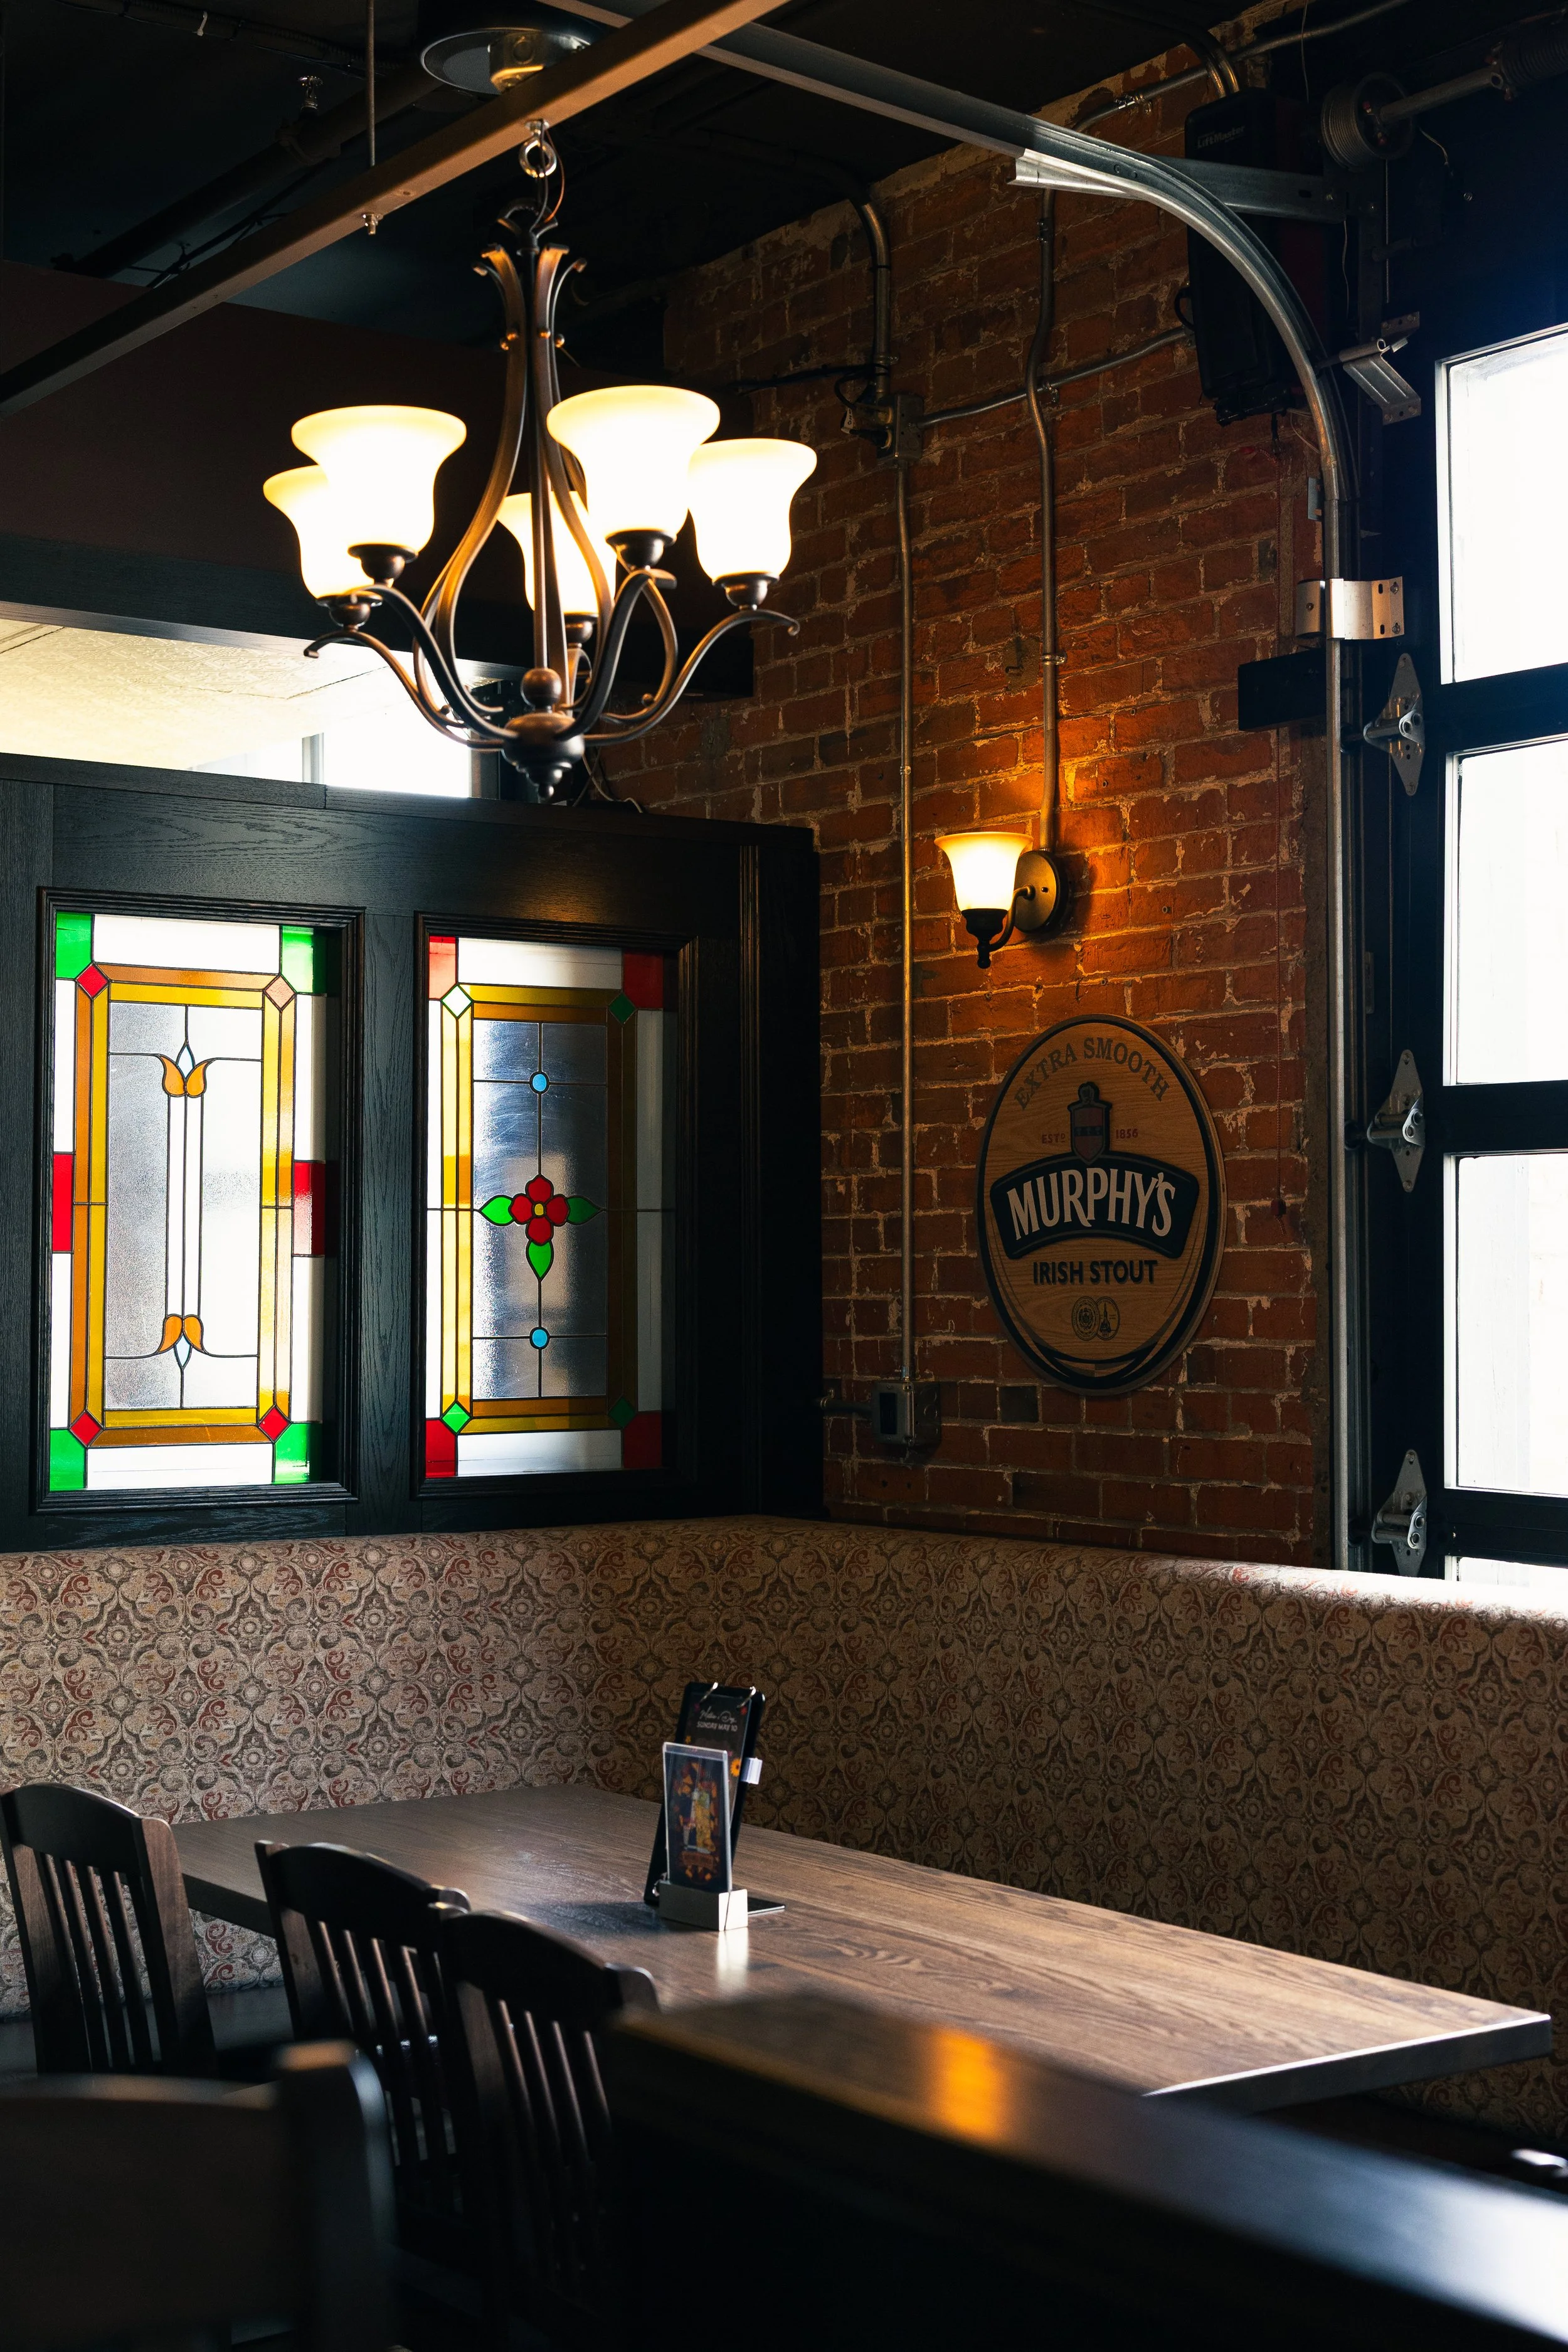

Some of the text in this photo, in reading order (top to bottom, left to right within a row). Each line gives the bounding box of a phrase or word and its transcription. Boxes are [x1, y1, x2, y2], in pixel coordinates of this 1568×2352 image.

[1197, 125, 1245, 149] LiftMaster
[1014, 1037, 1170, 1111] EXTRA SMOOTH
[1116, 1128, 1138, 1140] 1856
[1006, 1167, 1176, 1241] MURPHY'S
[1033, 1259, 1158, 1285] IRISH STOUT
